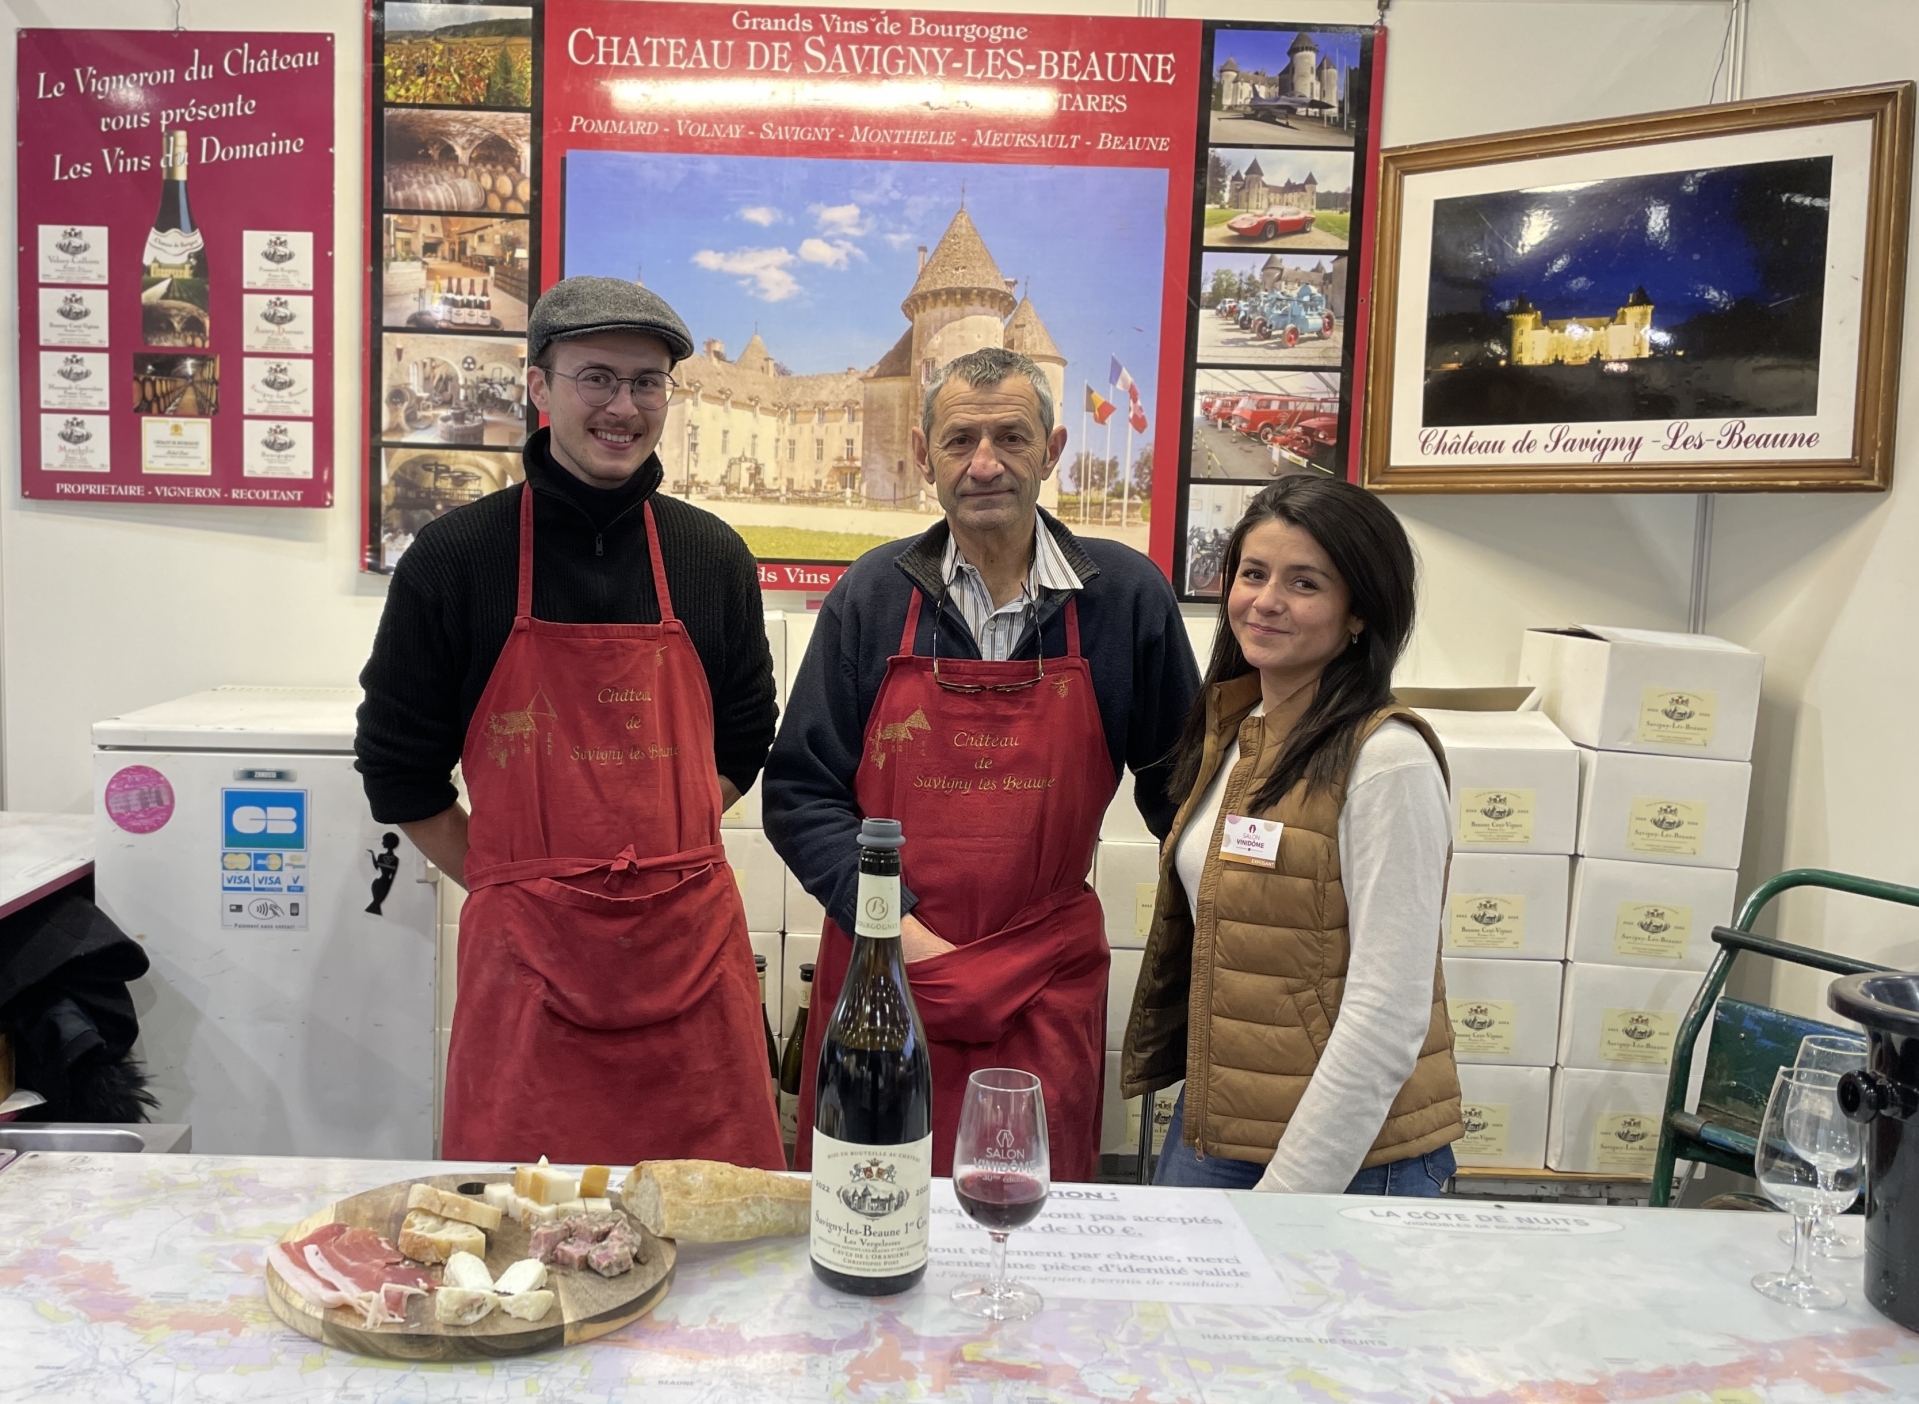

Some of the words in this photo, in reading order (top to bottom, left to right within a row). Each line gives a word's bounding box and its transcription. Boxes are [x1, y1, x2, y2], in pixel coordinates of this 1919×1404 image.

[732, 10, 813, 32] Grands
[820, 14, 868, 34] Vins
[875, 16, 901, 35] de
[909, 17, 1028, 43] Bourgogne
[567, 27, 734, 70] CHATEAU
[746, 41, 793, 73] DE
[803, 35, 1176, 85] SAVIGNY-LES-BEAUNE
[37, 72, 65, 99] Le
[74, 66, 175, 100] Vigneron
[184, 49, 214, 81] du
[223, 43, 320, 77] Château
[1057, 93, 1127, 113] TARES
[101, 111, 151, 132] vous
[160, 95, 257, 132] présente
[569, 115, 658, 136] POMMARD
[677, 120, 745, 138] VOLNAY
[759, 122, 835, 142] SAVIGNY
[850, 126, 956, 146] MONTHELIE
[972, 129, 1081, 149] MEURSAULT
[1096, 133, 1170, 152] BEAUNE
[52, 154, 93, 181] Les
[102, 147, 151, 176] Vins
[160, 136, 189, 169] du
[200, 133, 304, 164] Domaine
[1418, 428, 1505, 456] Château
[1512, 430, 1537, 454] de
[1543, 424, 1644, 463] Savigny
[56, 483, 145, 497] PROPRIETAIRE
[155, 486, 221, 499] VIGNERON
[231, 489, 303, 501] RECOLTANT
[784, 567, 831, 584] Vins
[626, 713, 641, 730] de
[953, 731, 1019, 747] Château
[974, 755, 993, 770] de
[914, 774, 973, 795] Savigny
[978, 776, 997, 790] lès
[1003, 775, 1055, 791] Beaune
[226, 875, 251, 884] VISA
[257, 875, 281, 885] VISA
[986, 1147, 1025, 1160] SALON
[973, 1157, 1037, 1173] VINIDÔME
[815, 1180, 830, 1194] 2022
[815, 1209, 901, 1238] Savigny-les-Beaune
[1040, 1210, 1085, 1220] sont
[1089, 1213, 1126, 1223] pas
[1133, 1214, 1223, 1226] acceptés
[1369, 1209, 1401, 1218] LA
[1407, 1211, 1470, 1221] CÔTE
[1475, 1214, 1510, 1223] DE
[1514, 1216, 1590, 1227] NUITS
[1040, 1223, 1067, 1233] de
[1076, 1224, 1115, 1236] 100
[844, 1236, 856, 1245] Les
[860, 1238, 901, 1249] Vergelesses
[832, 1248, 853, 1258] CAVES
[1067, 1251, 1101, 1260] par
[1107, 1252, 1181, 1263] chèque,
[1187, 1255, 1242, 1265] merci
[1042, 1262, 1092, 1272] pièce
[1099, 1264, 1189, 1275] d'identité
[1193, 1267, 1251, 1278] valide
